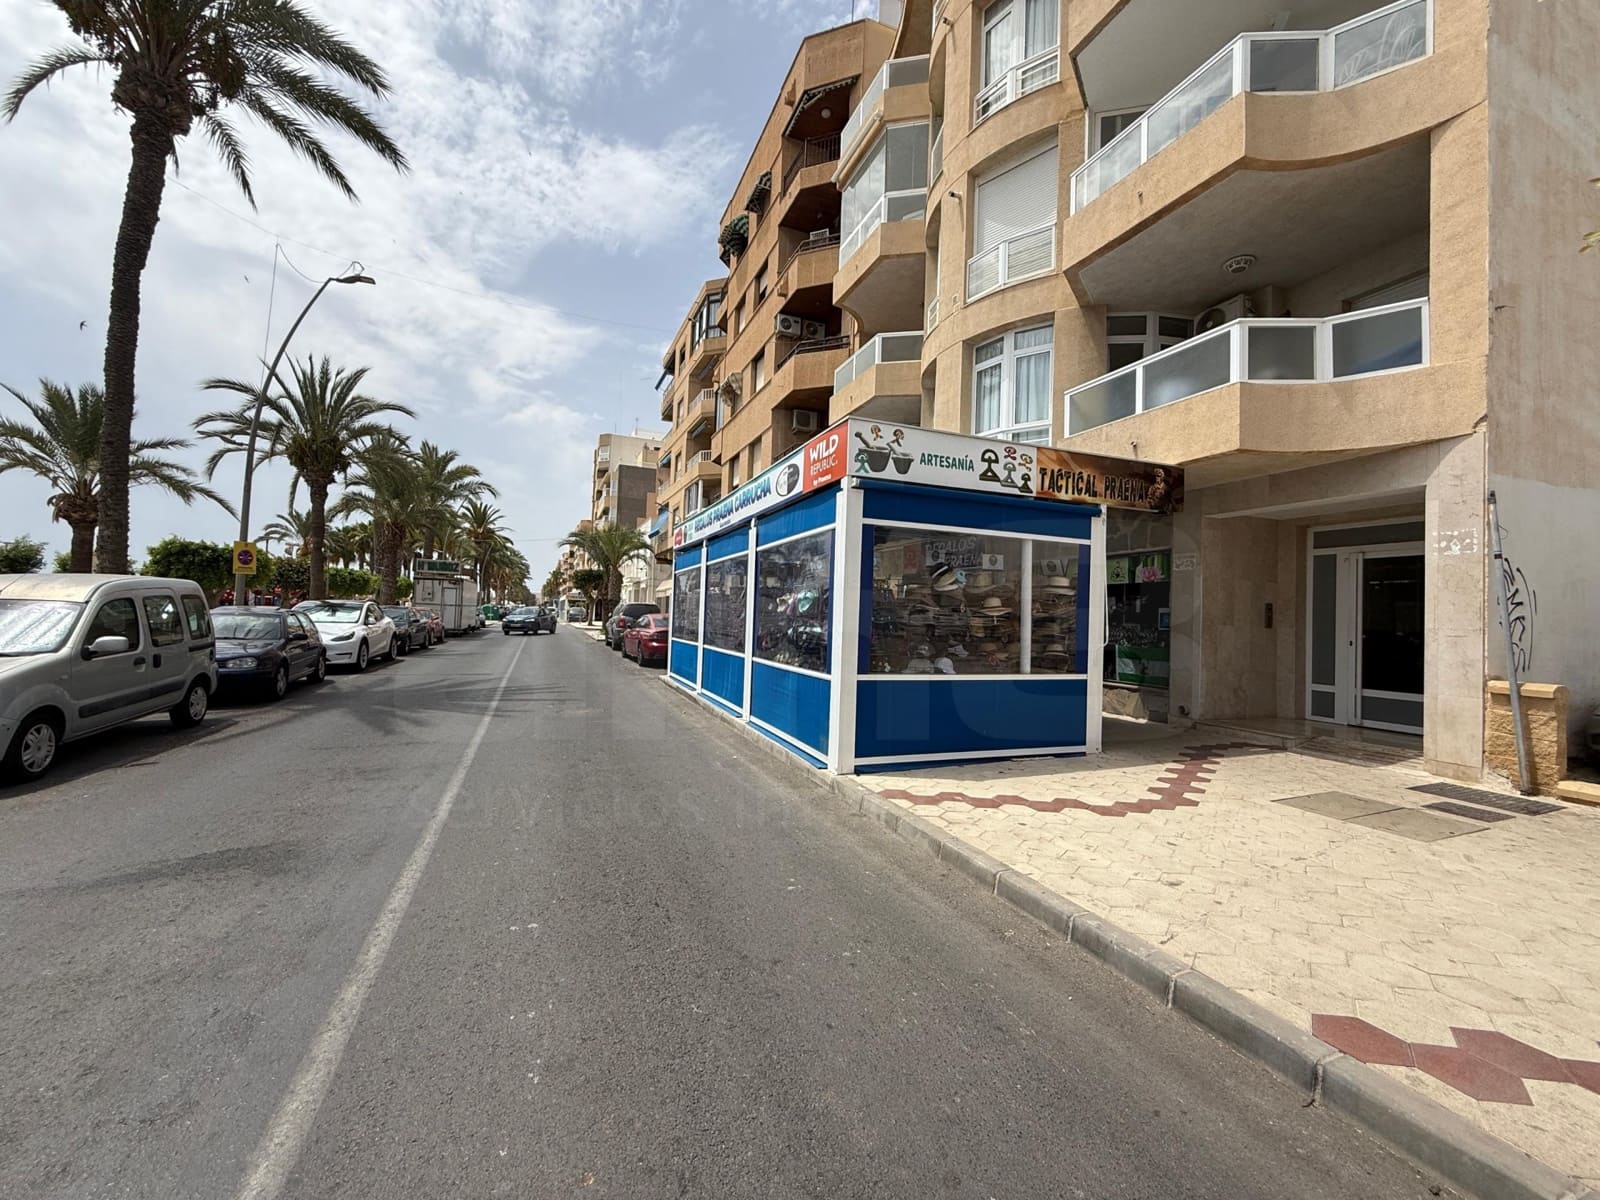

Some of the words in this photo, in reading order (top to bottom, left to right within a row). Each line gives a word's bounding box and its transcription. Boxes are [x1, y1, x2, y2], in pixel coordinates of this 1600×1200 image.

[809, 434, 839, 463] WILD
[919, 452, 975, 473] ARTESANÍA
[1039, 467, 1098, 498] TACTICAL
